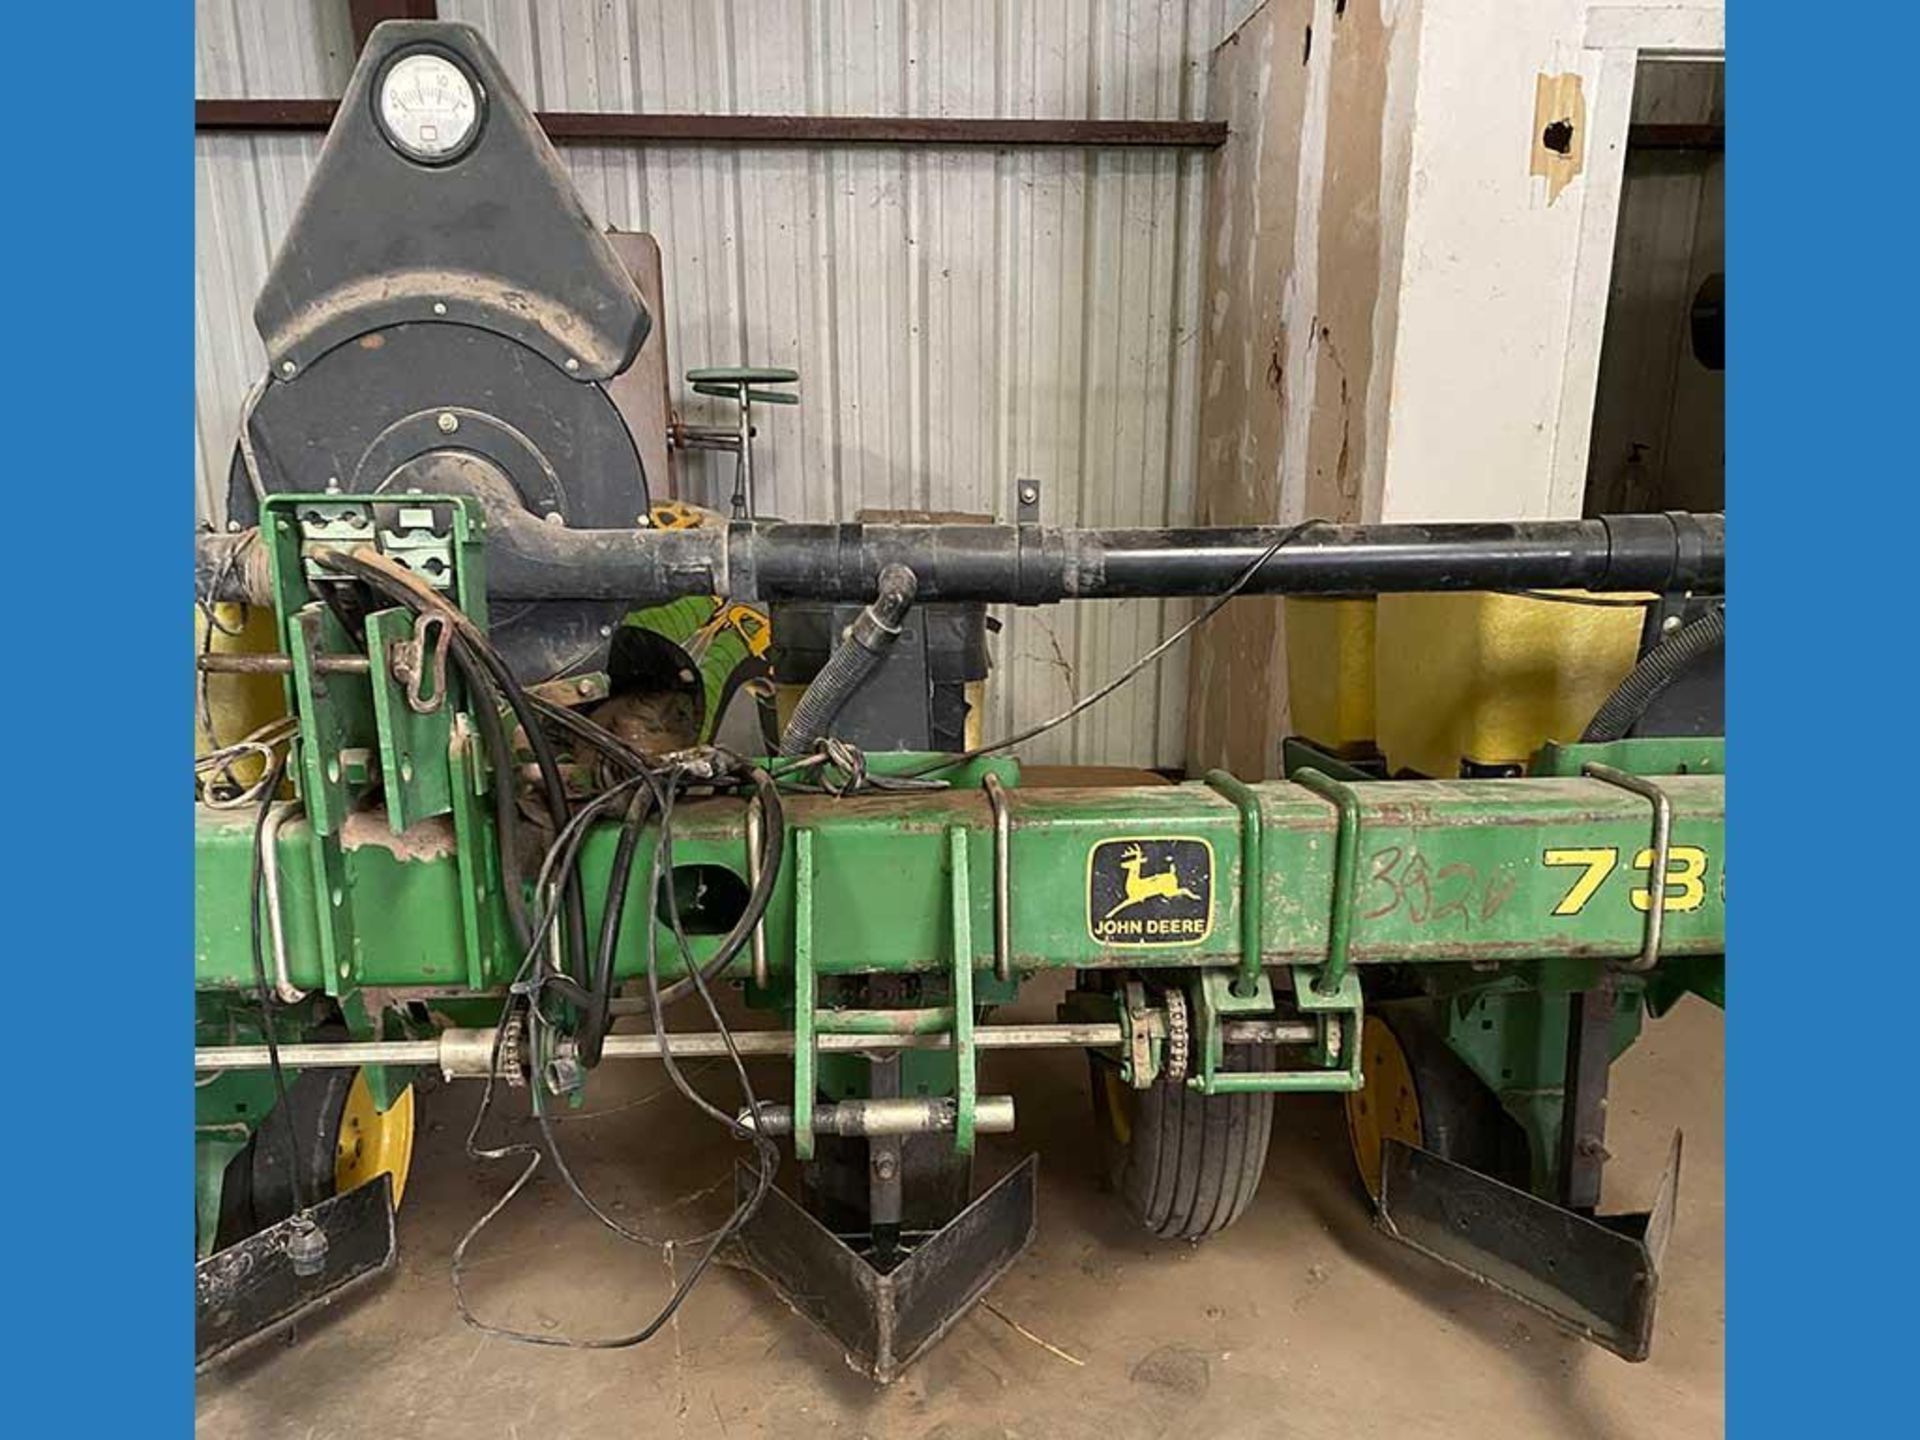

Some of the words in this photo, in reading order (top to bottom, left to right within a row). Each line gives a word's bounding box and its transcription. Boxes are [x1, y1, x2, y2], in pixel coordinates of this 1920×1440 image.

[1542, 846, 1725, 913] 73
[1094, 920, 1142, 934] JOHN
[1147, 920, 1205, 934] DEERE
